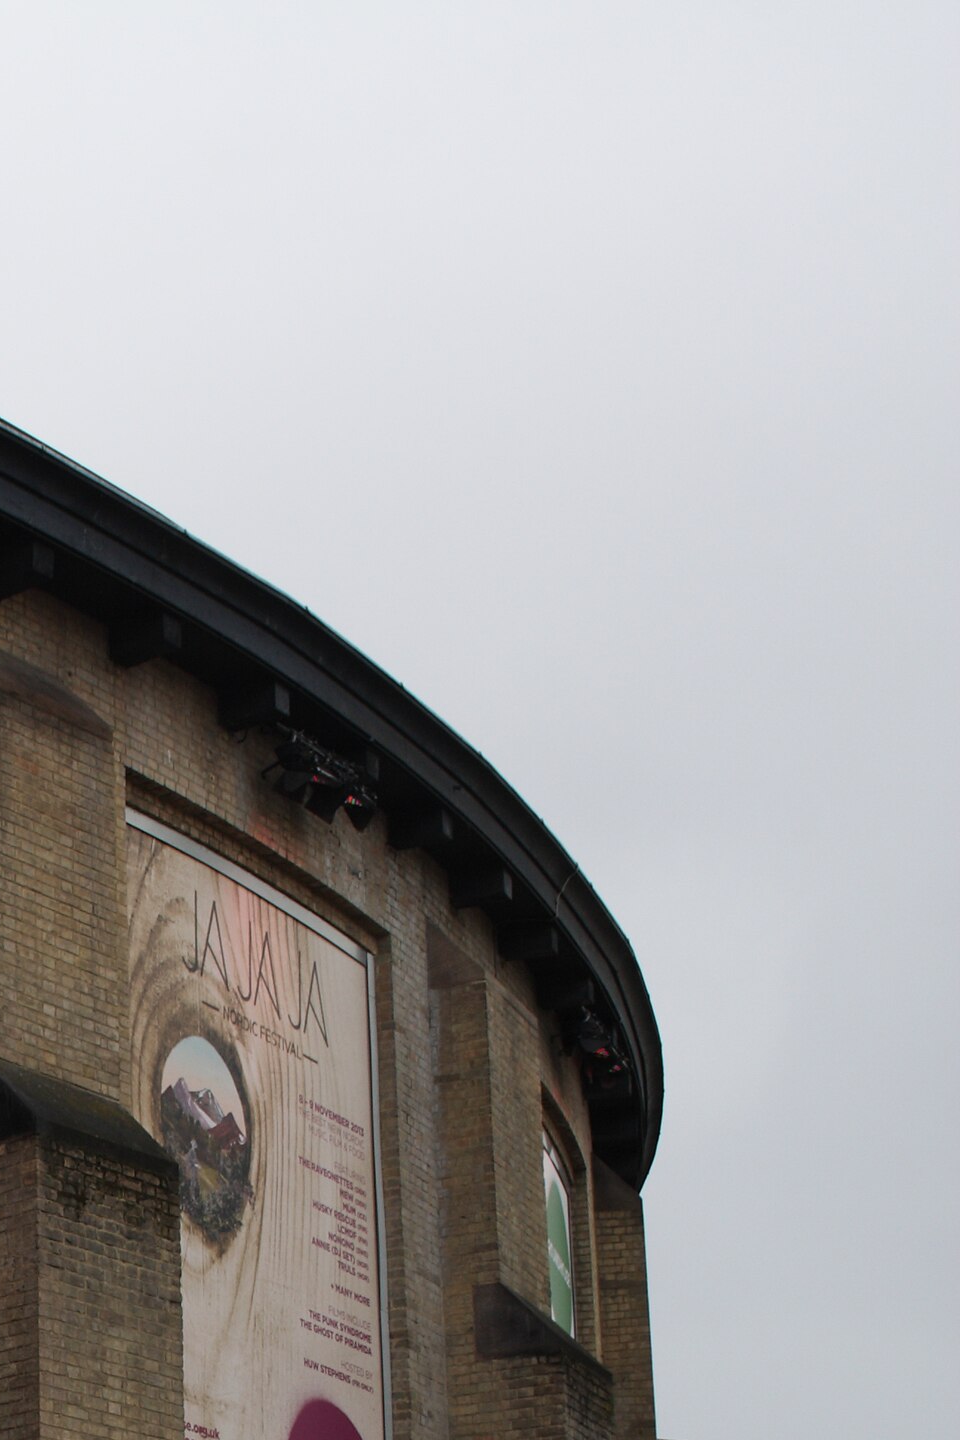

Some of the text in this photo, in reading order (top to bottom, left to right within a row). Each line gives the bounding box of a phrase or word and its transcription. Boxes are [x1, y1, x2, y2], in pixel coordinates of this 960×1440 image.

[222, 1005, 302, 1060] NORDIC FESTIVAL
[315, 1102, 349, 1129] NOVEMBER
[335, 1283, 352, 1298] MANY
[354, 1293, 370, 1307] MORE
[300, 1318, 312, 1331] THE
[313, 1324, 334, 1340] GHOST
[309, 1309, 372, 1344] THE PUNK SYNDROME
[320, 1364, 351, 1384] STEPHENS
